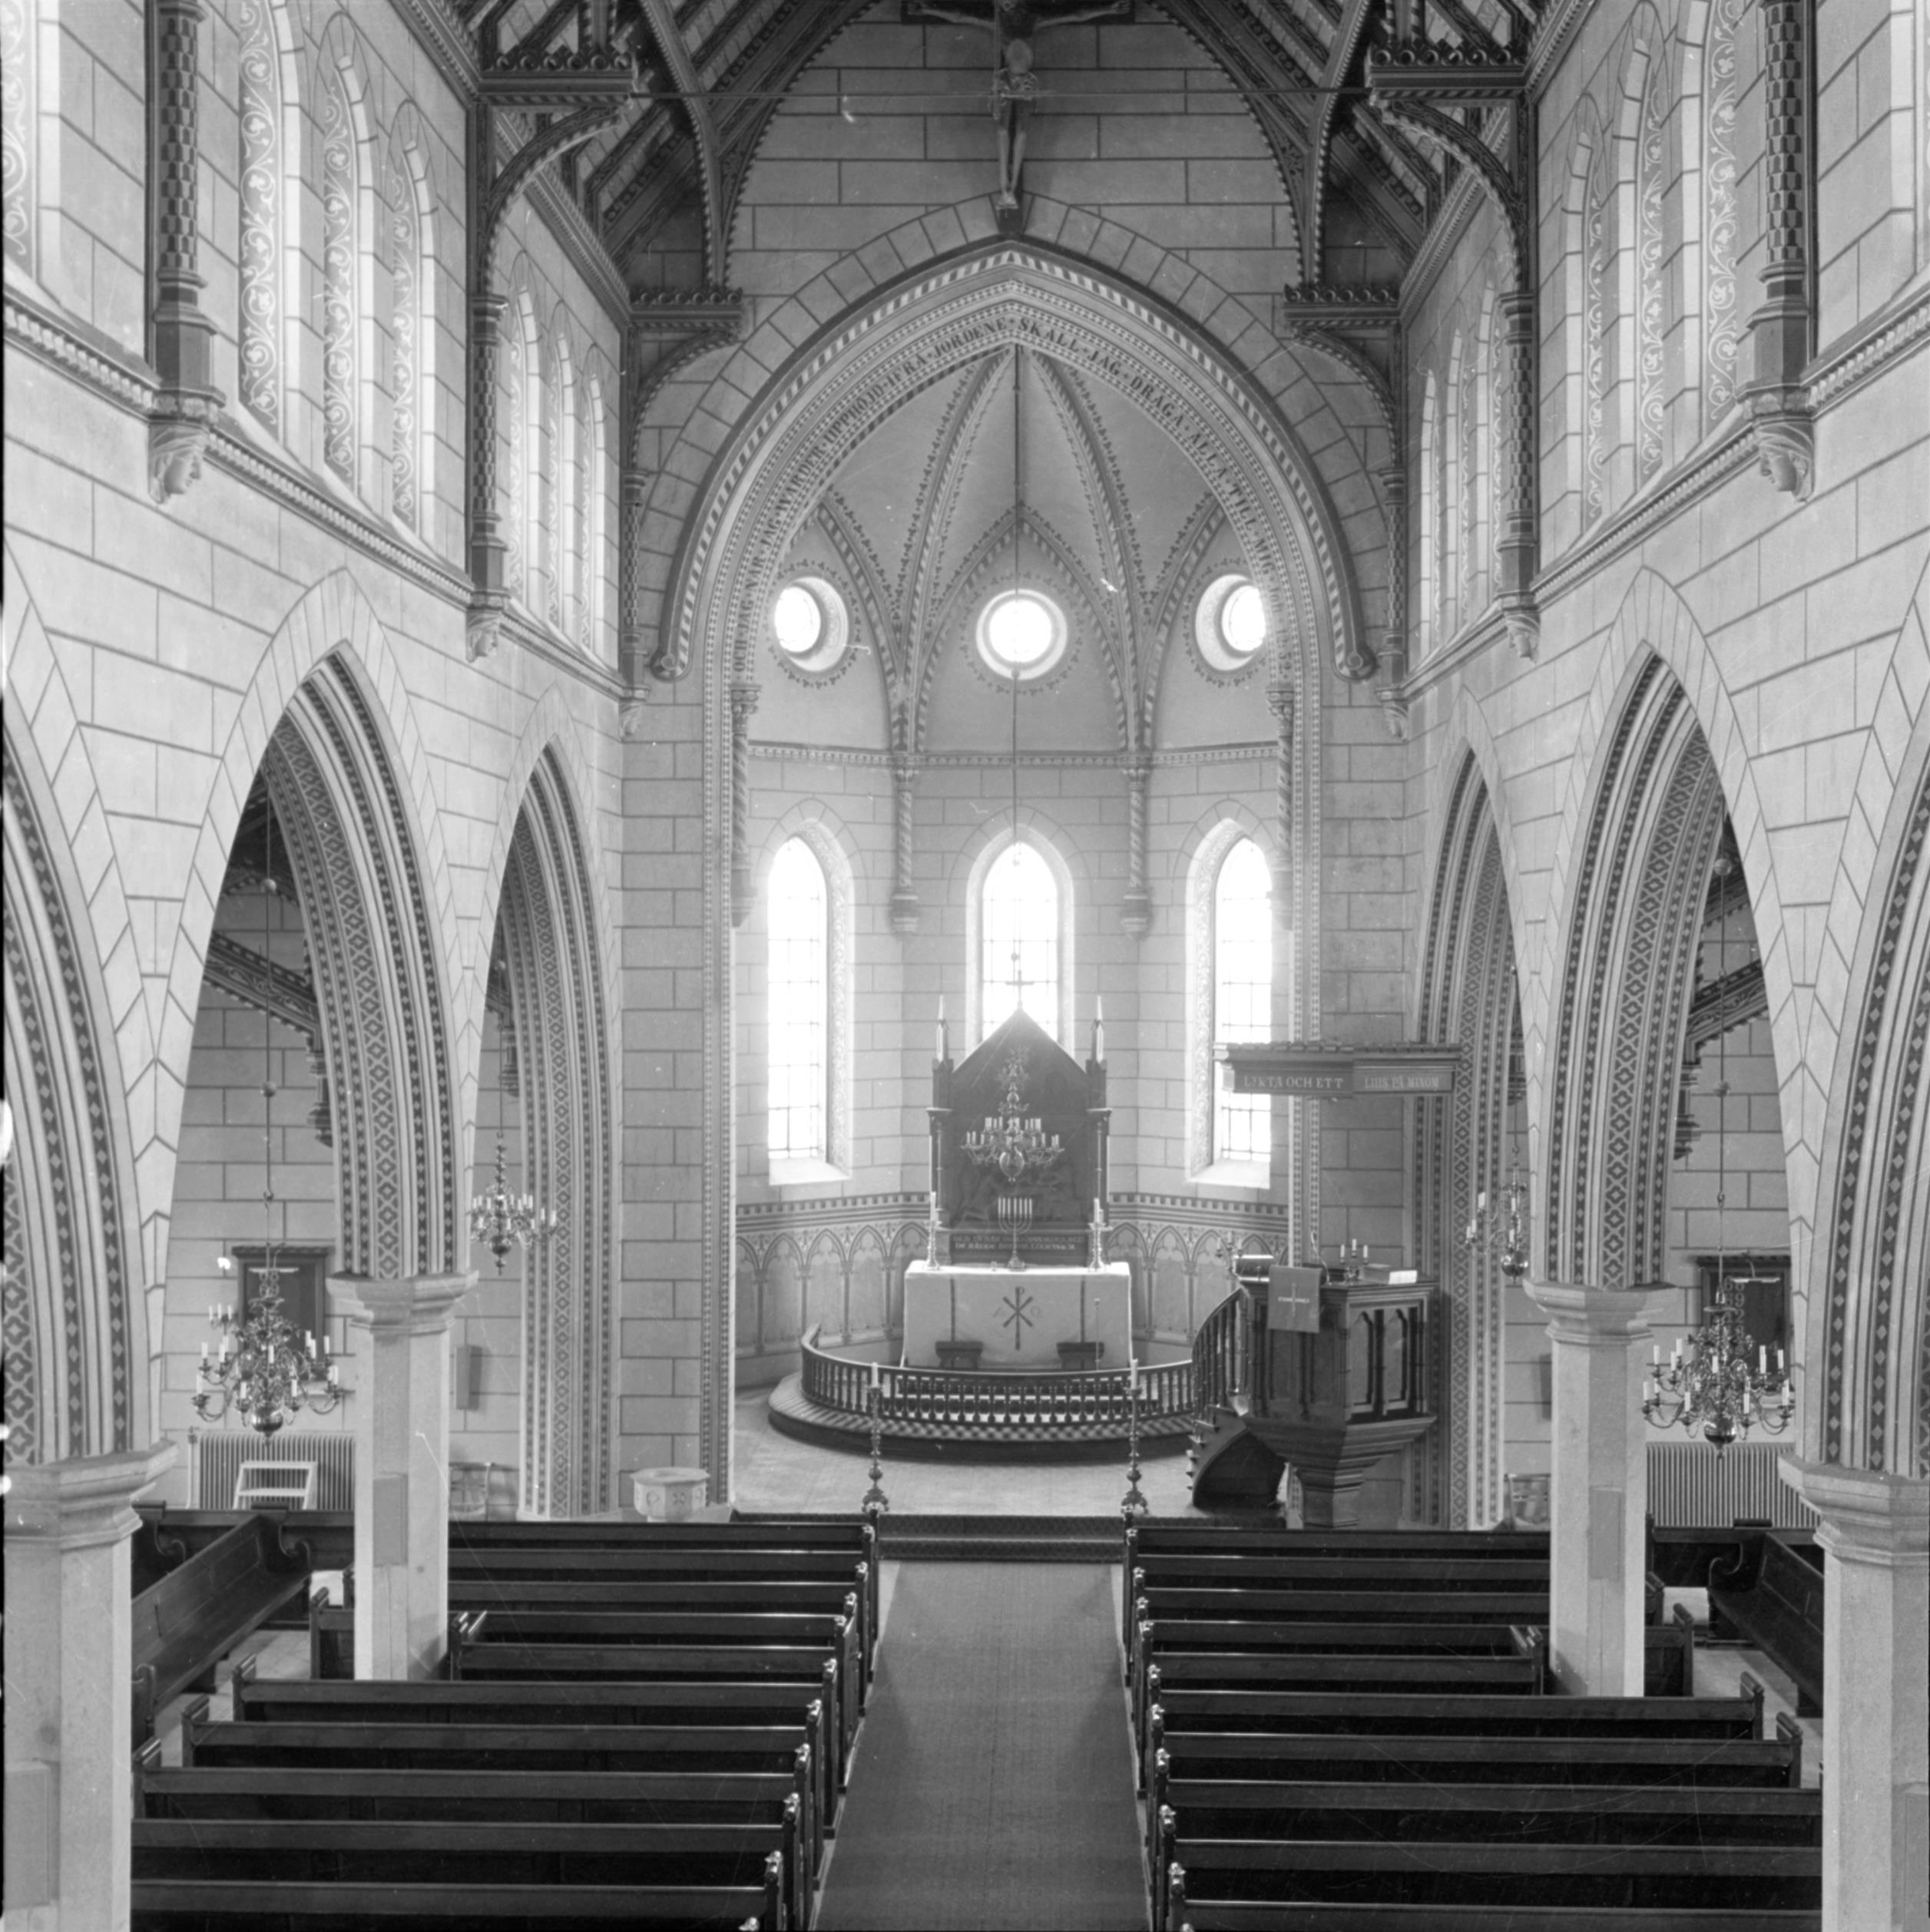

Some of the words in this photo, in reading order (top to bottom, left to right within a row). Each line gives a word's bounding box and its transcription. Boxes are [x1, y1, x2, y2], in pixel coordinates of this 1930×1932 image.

[934, 316, 1008, 358] JORDENE
[1018, 317, 1079, 352] SKALL
[1087, 350, 1122, 375] JAG
[1131, 375, 1184, 427] DRAGA
[1188, 432, 1227, 478] ALLA
[1229, 483, 1257, 531] TILL
[760, 518, 782, 550] JAG
[1252, 538, 1276, 574] MIG
[737, 600, 755, 634] JAG
[733, 640, 748, 673] OCH
[1286, 1075, 1313, 1088] OCH
[1316, 1077, 1344, 1089] ETT
